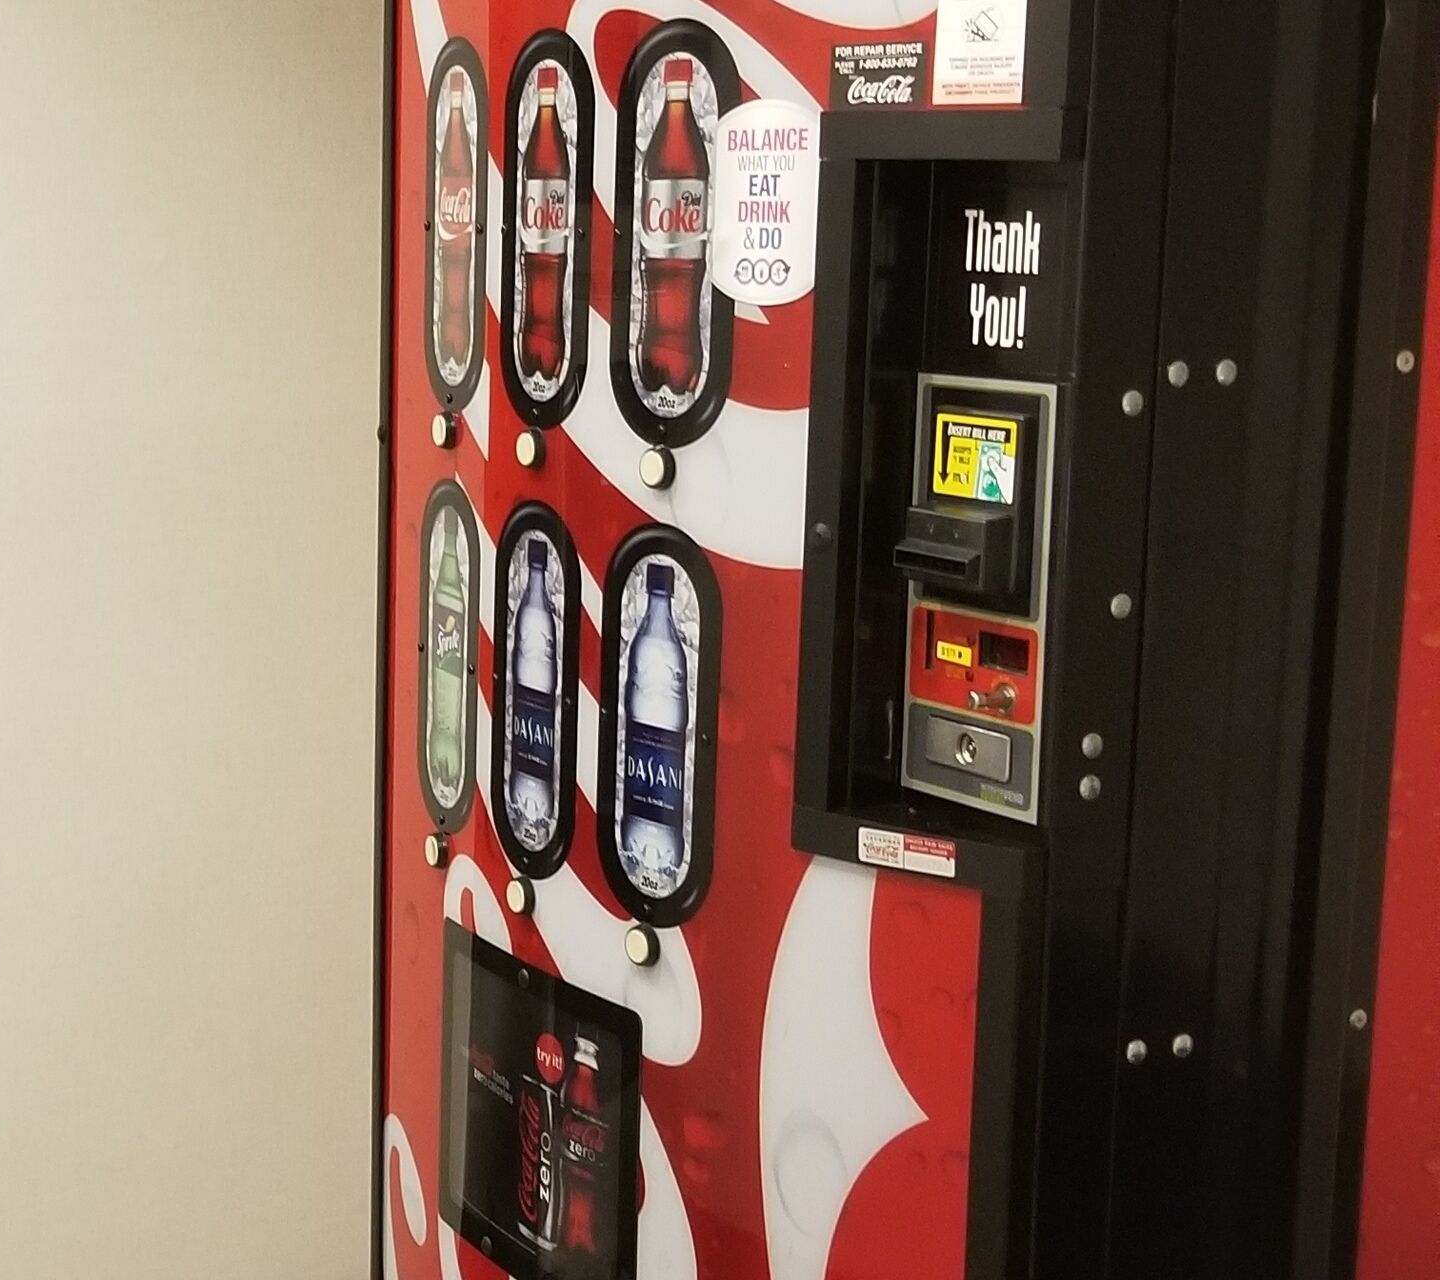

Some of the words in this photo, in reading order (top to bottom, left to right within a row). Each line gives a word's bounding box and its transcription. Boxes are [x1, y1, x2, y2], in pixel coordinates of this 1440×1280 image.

[835, 46, 852, 58] FOR
[853, 44, 885, 56] REPAIR
[885, 42, 923, 55] SERVICE
[728, 128, 809, 152] BALANCE
[737, 154, 769, 171] WHAT
[773, 154, 795, 171] YOU
[524, 195, 564, 230] Coke
[646, 197, 702, 233] Coke
[737, 200, 791, 223] DRINK
[743, 226, 756, 250] &
[759, 227, 782, 250] DO
[964, 207, 1042, 276] Thank
[969, 281, 1027, 350] You!
[513, 714, 554, 749] DASANI
[627, 754, 683, 792] DASANI
[536, 1046, 551, 1067] try
[551, 1052, 563, 1072] it!
[568, 1138, 596, 1162] zero
[539, 1131, 552, 1203] zero
